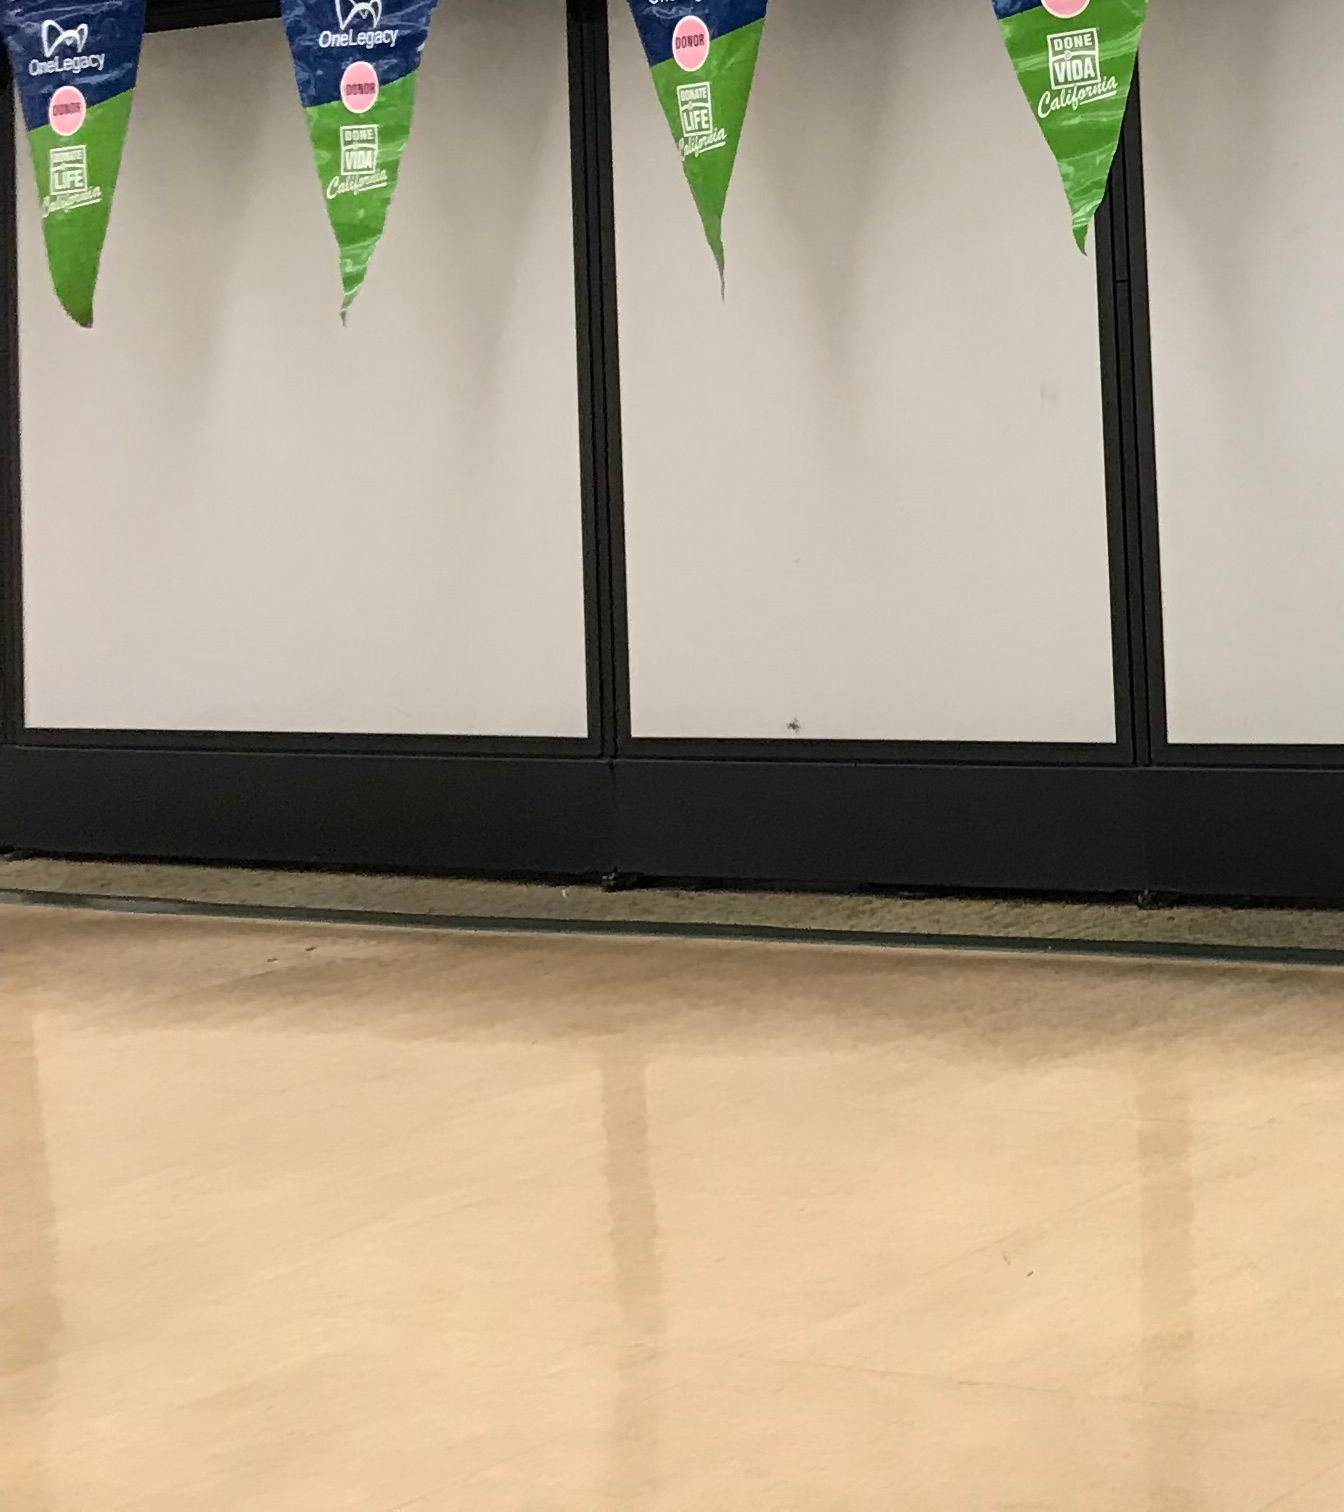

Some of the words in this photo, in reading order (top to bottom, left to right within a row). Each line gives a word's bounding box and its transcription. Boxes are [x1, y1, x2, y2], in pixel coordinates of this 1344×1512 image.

[319, 29, 399, 49] OneLegacy
[675, 33, 705, 51] DONOR
[1053, 33, 1092, 52] DONE
[29, 51, 105, 76] OneLegacy
[1053, 58, 1095, 83] VIDA
[1037, 75, 1119, 119] California
[683, 110, 710, 131] LIFE
[344, 129, 374, 141] DONE
[345, 150, 372, 170] VIDA
[54, 170, 84, 189] LIFE
[326, 170, 388, 199] California
